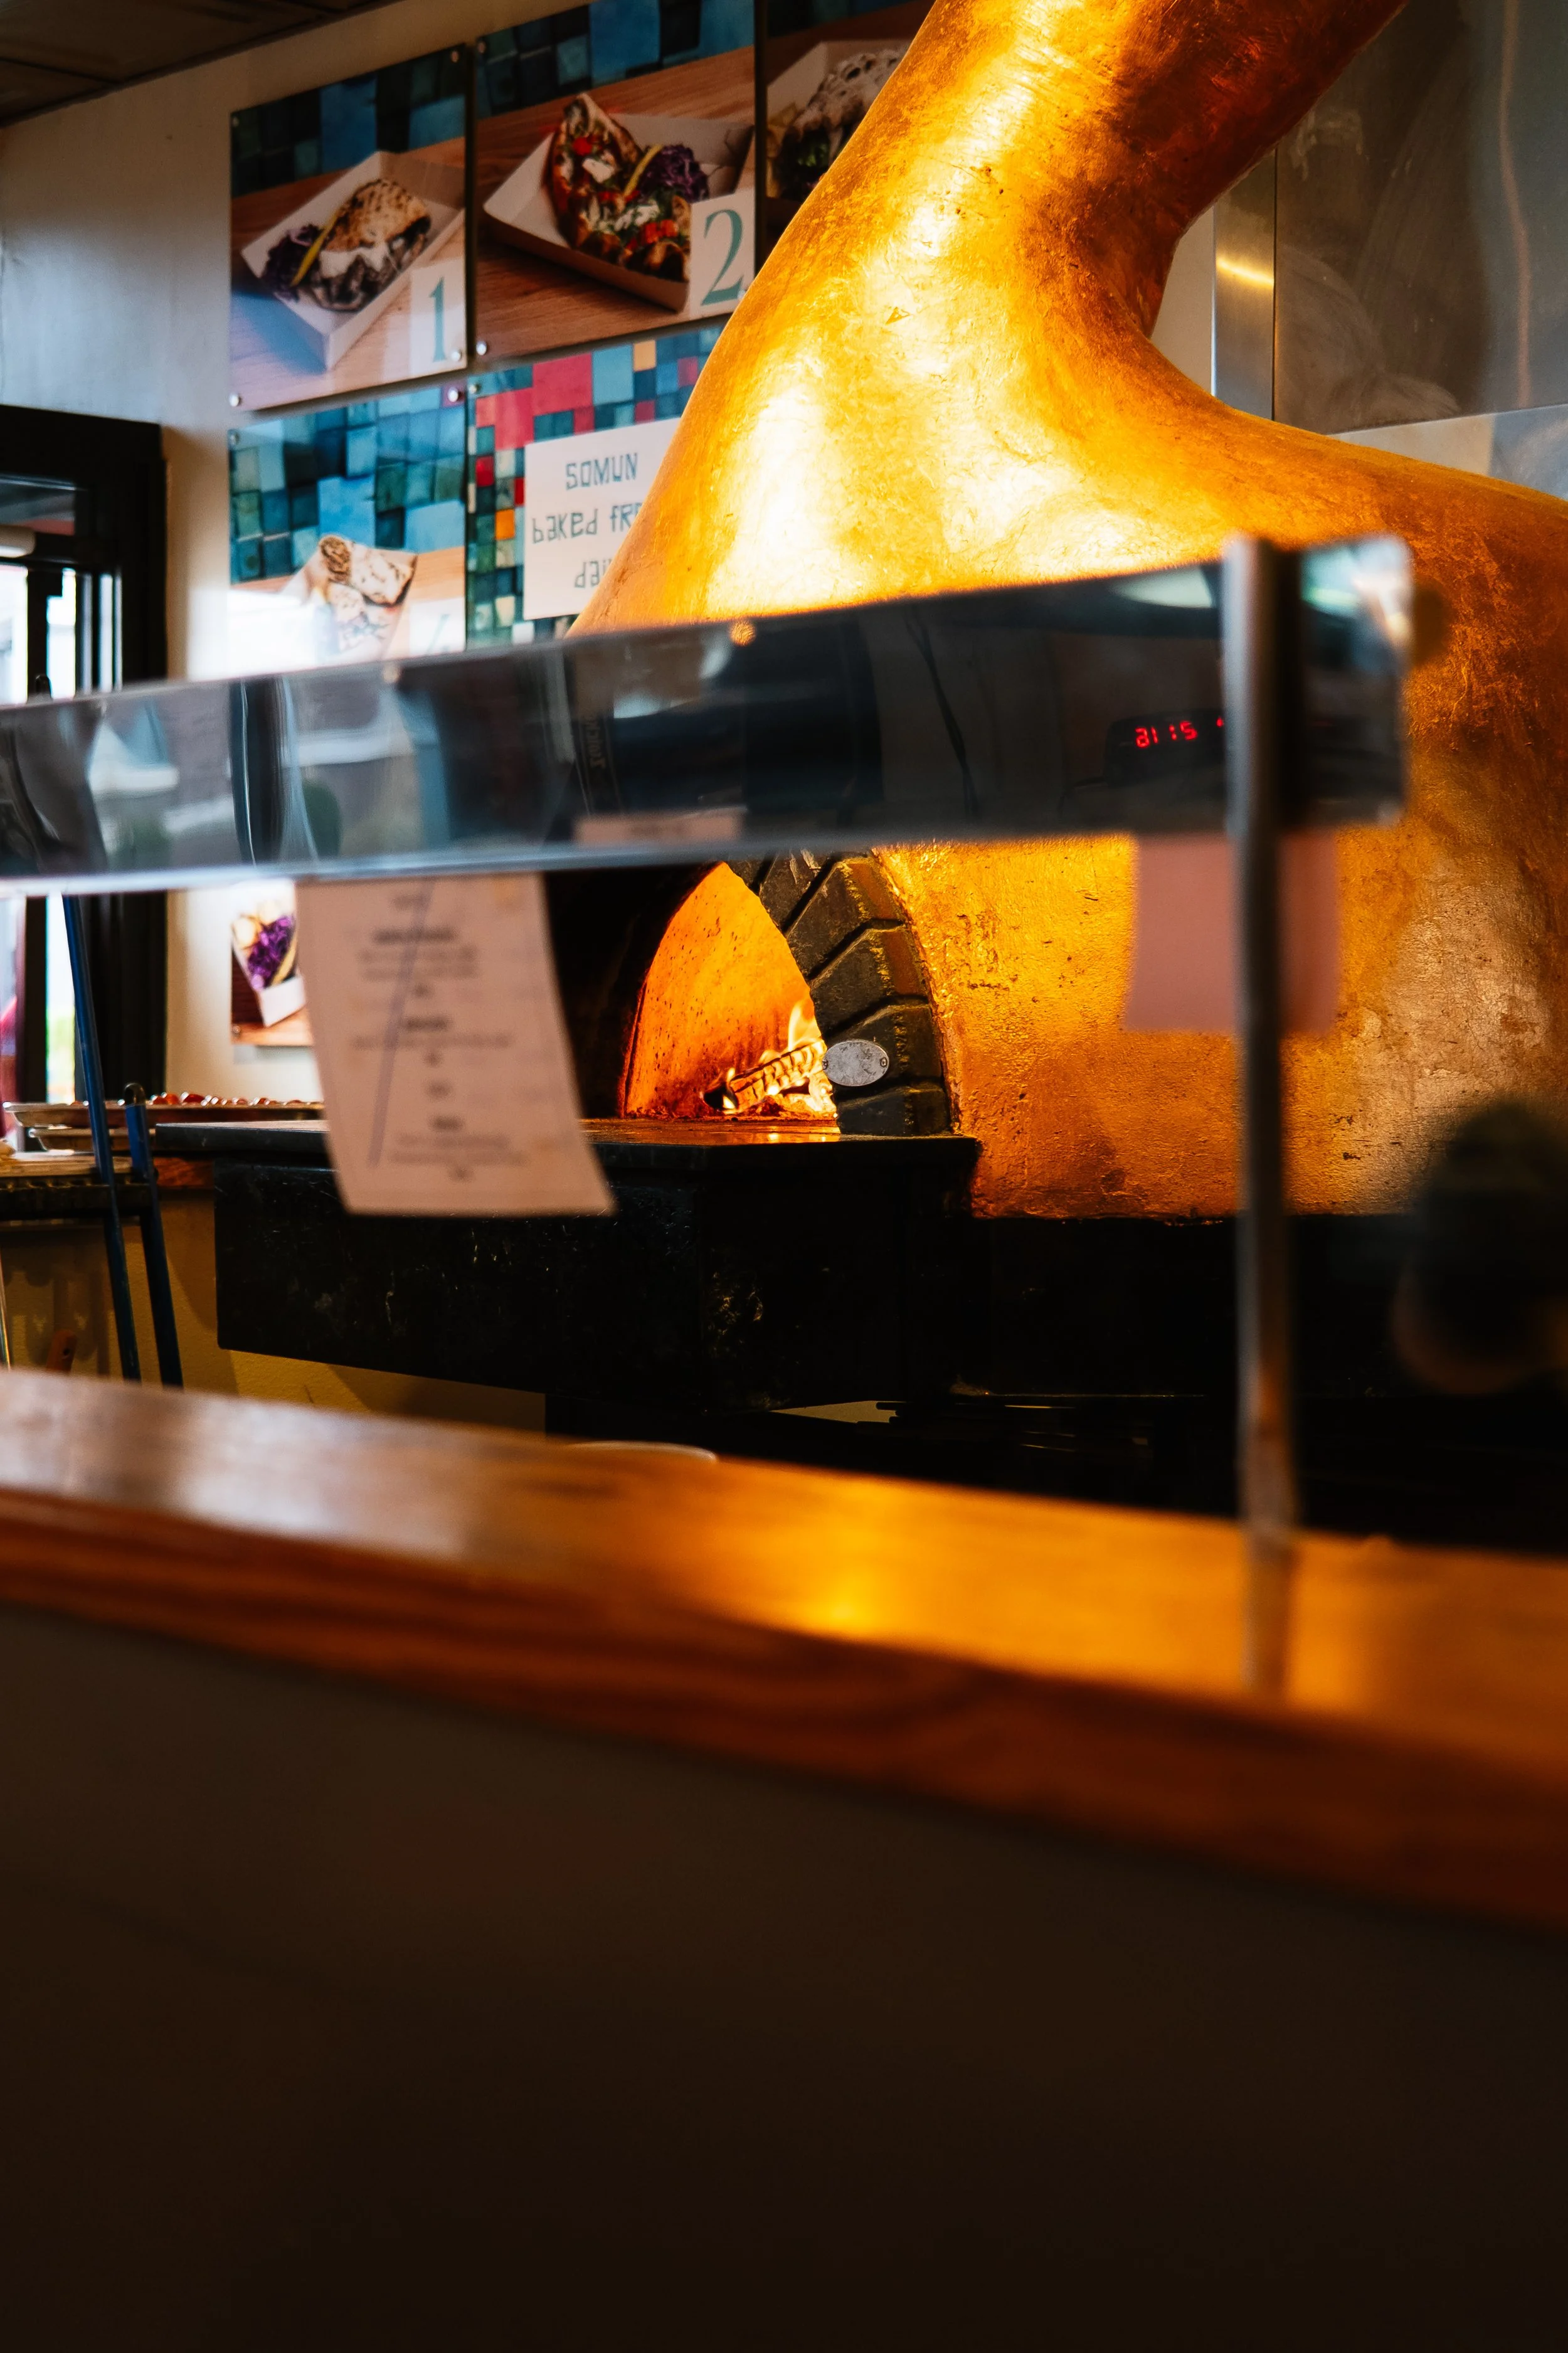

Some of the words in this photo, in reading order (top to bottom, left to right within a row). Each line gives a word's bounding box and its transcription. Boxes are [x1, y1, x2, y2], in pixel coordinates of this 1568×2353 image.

[701, 208, 744, 307] 2
[429, 276, 448, 363] 1
[566, 452, 638, 491] SOMUN
